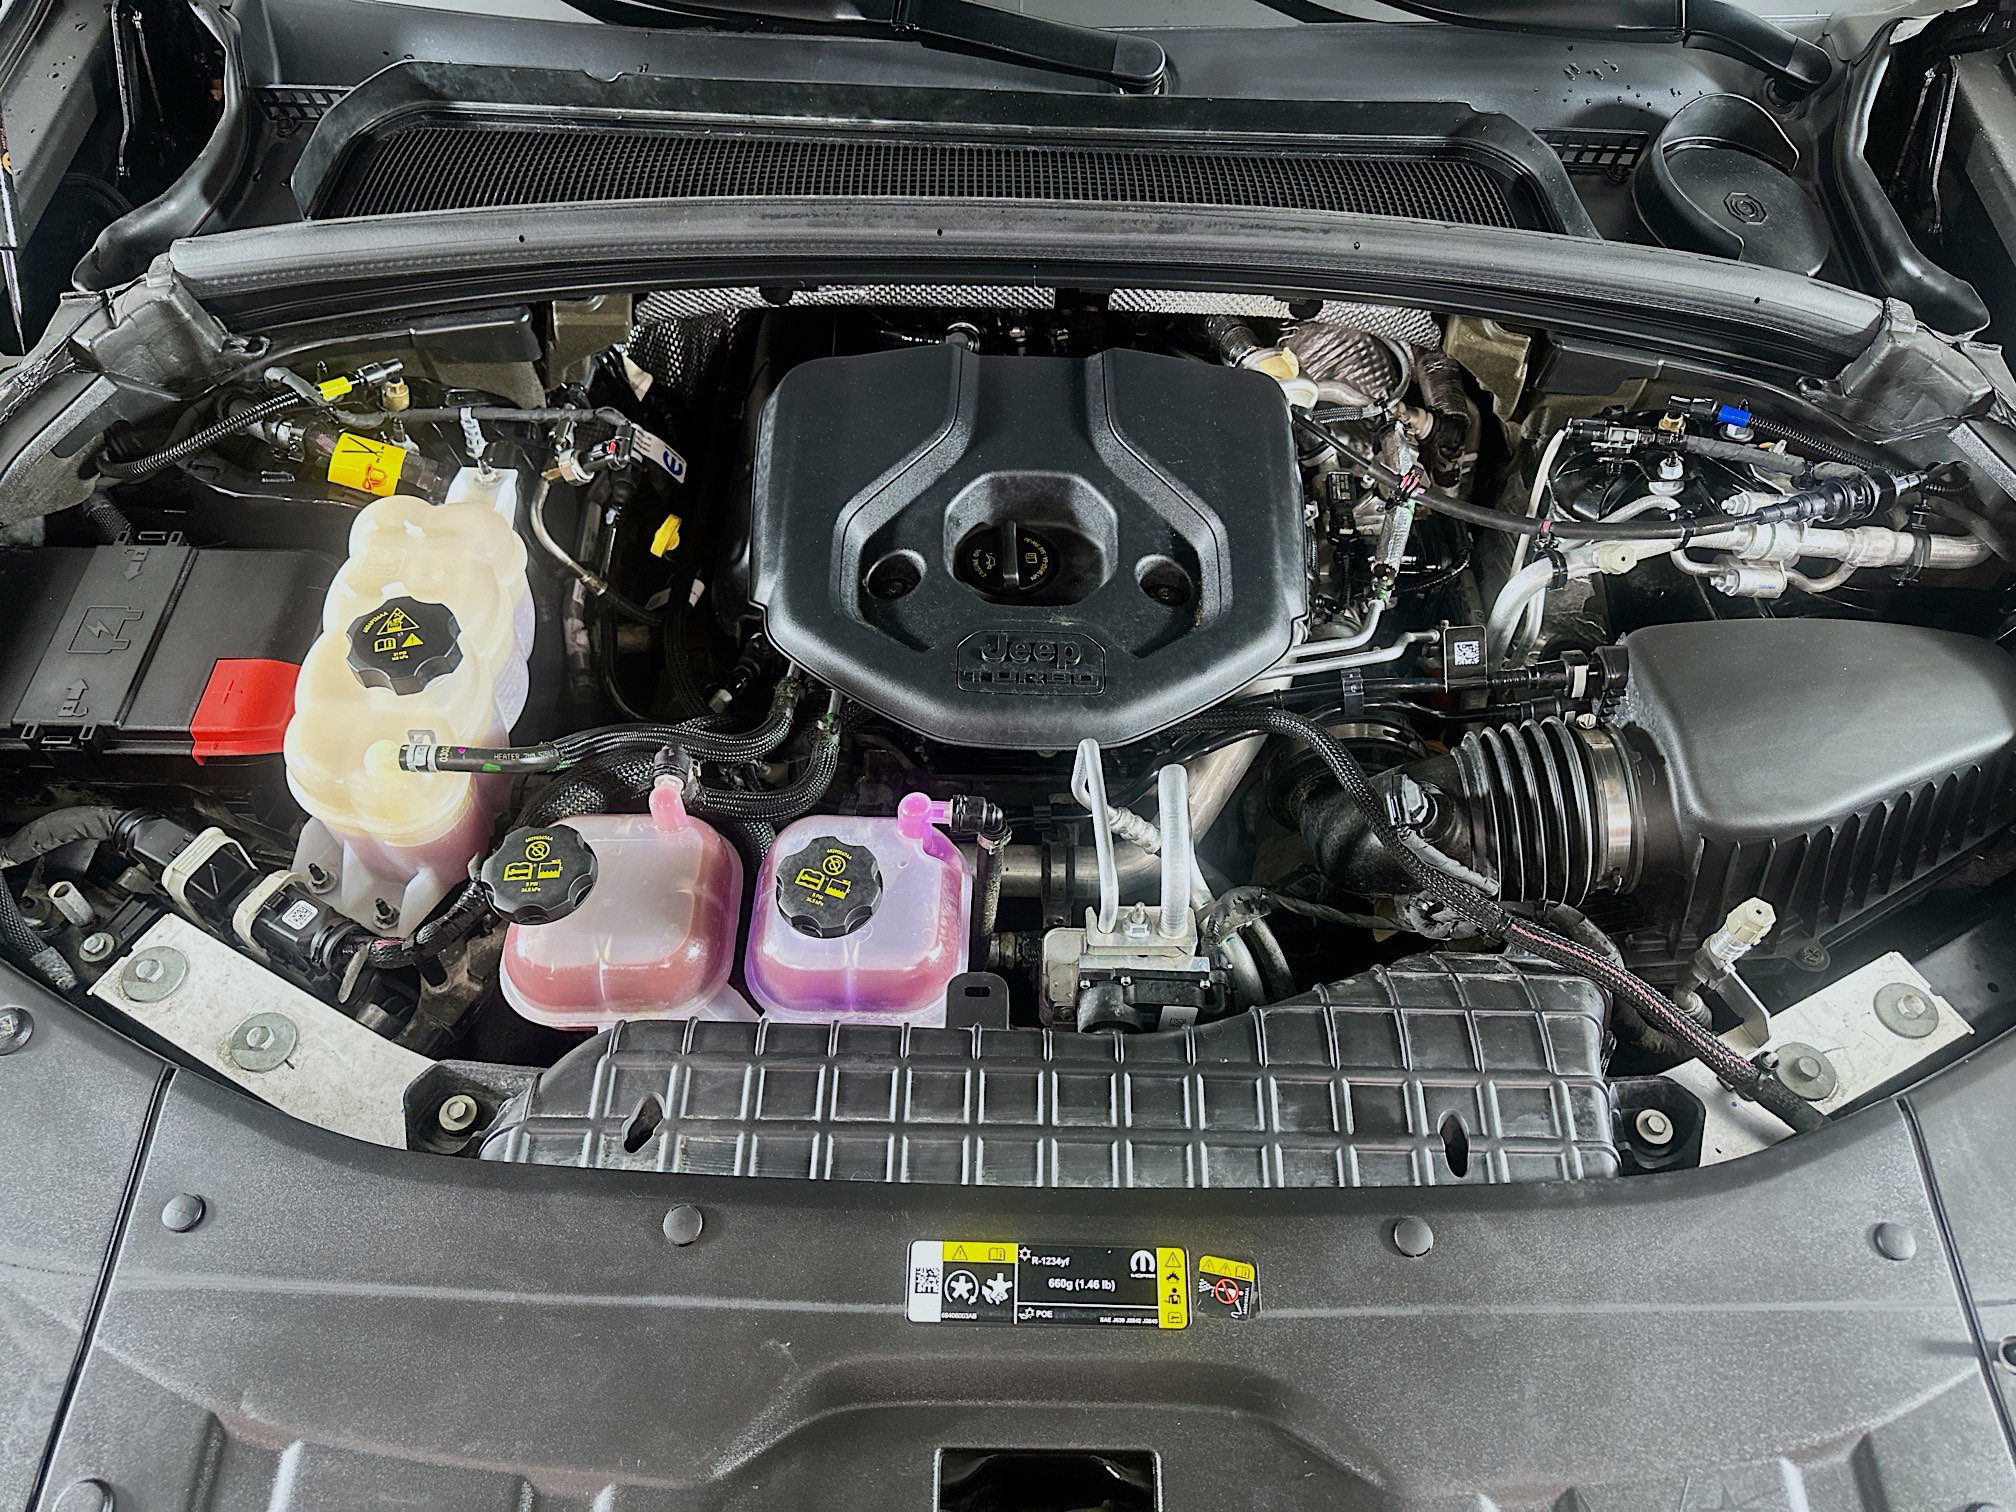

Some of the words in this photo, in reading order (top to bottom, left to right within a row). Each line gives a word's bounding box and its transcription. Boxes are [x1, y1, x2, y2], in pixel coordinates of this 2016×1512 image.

[981, 633, 1082, 669] Jeep
[964, 671, 1099, 686] TURBO
[1031, 1256, 1070, 1267] R-1234yf
[1048, 1278, 1073, 1291] 660g
[1075, 1279, 1100, 1291] (1.46
[1102, 1279, 1116, 1292] lb)
[1036, 1309, 1053, 1318] POE
